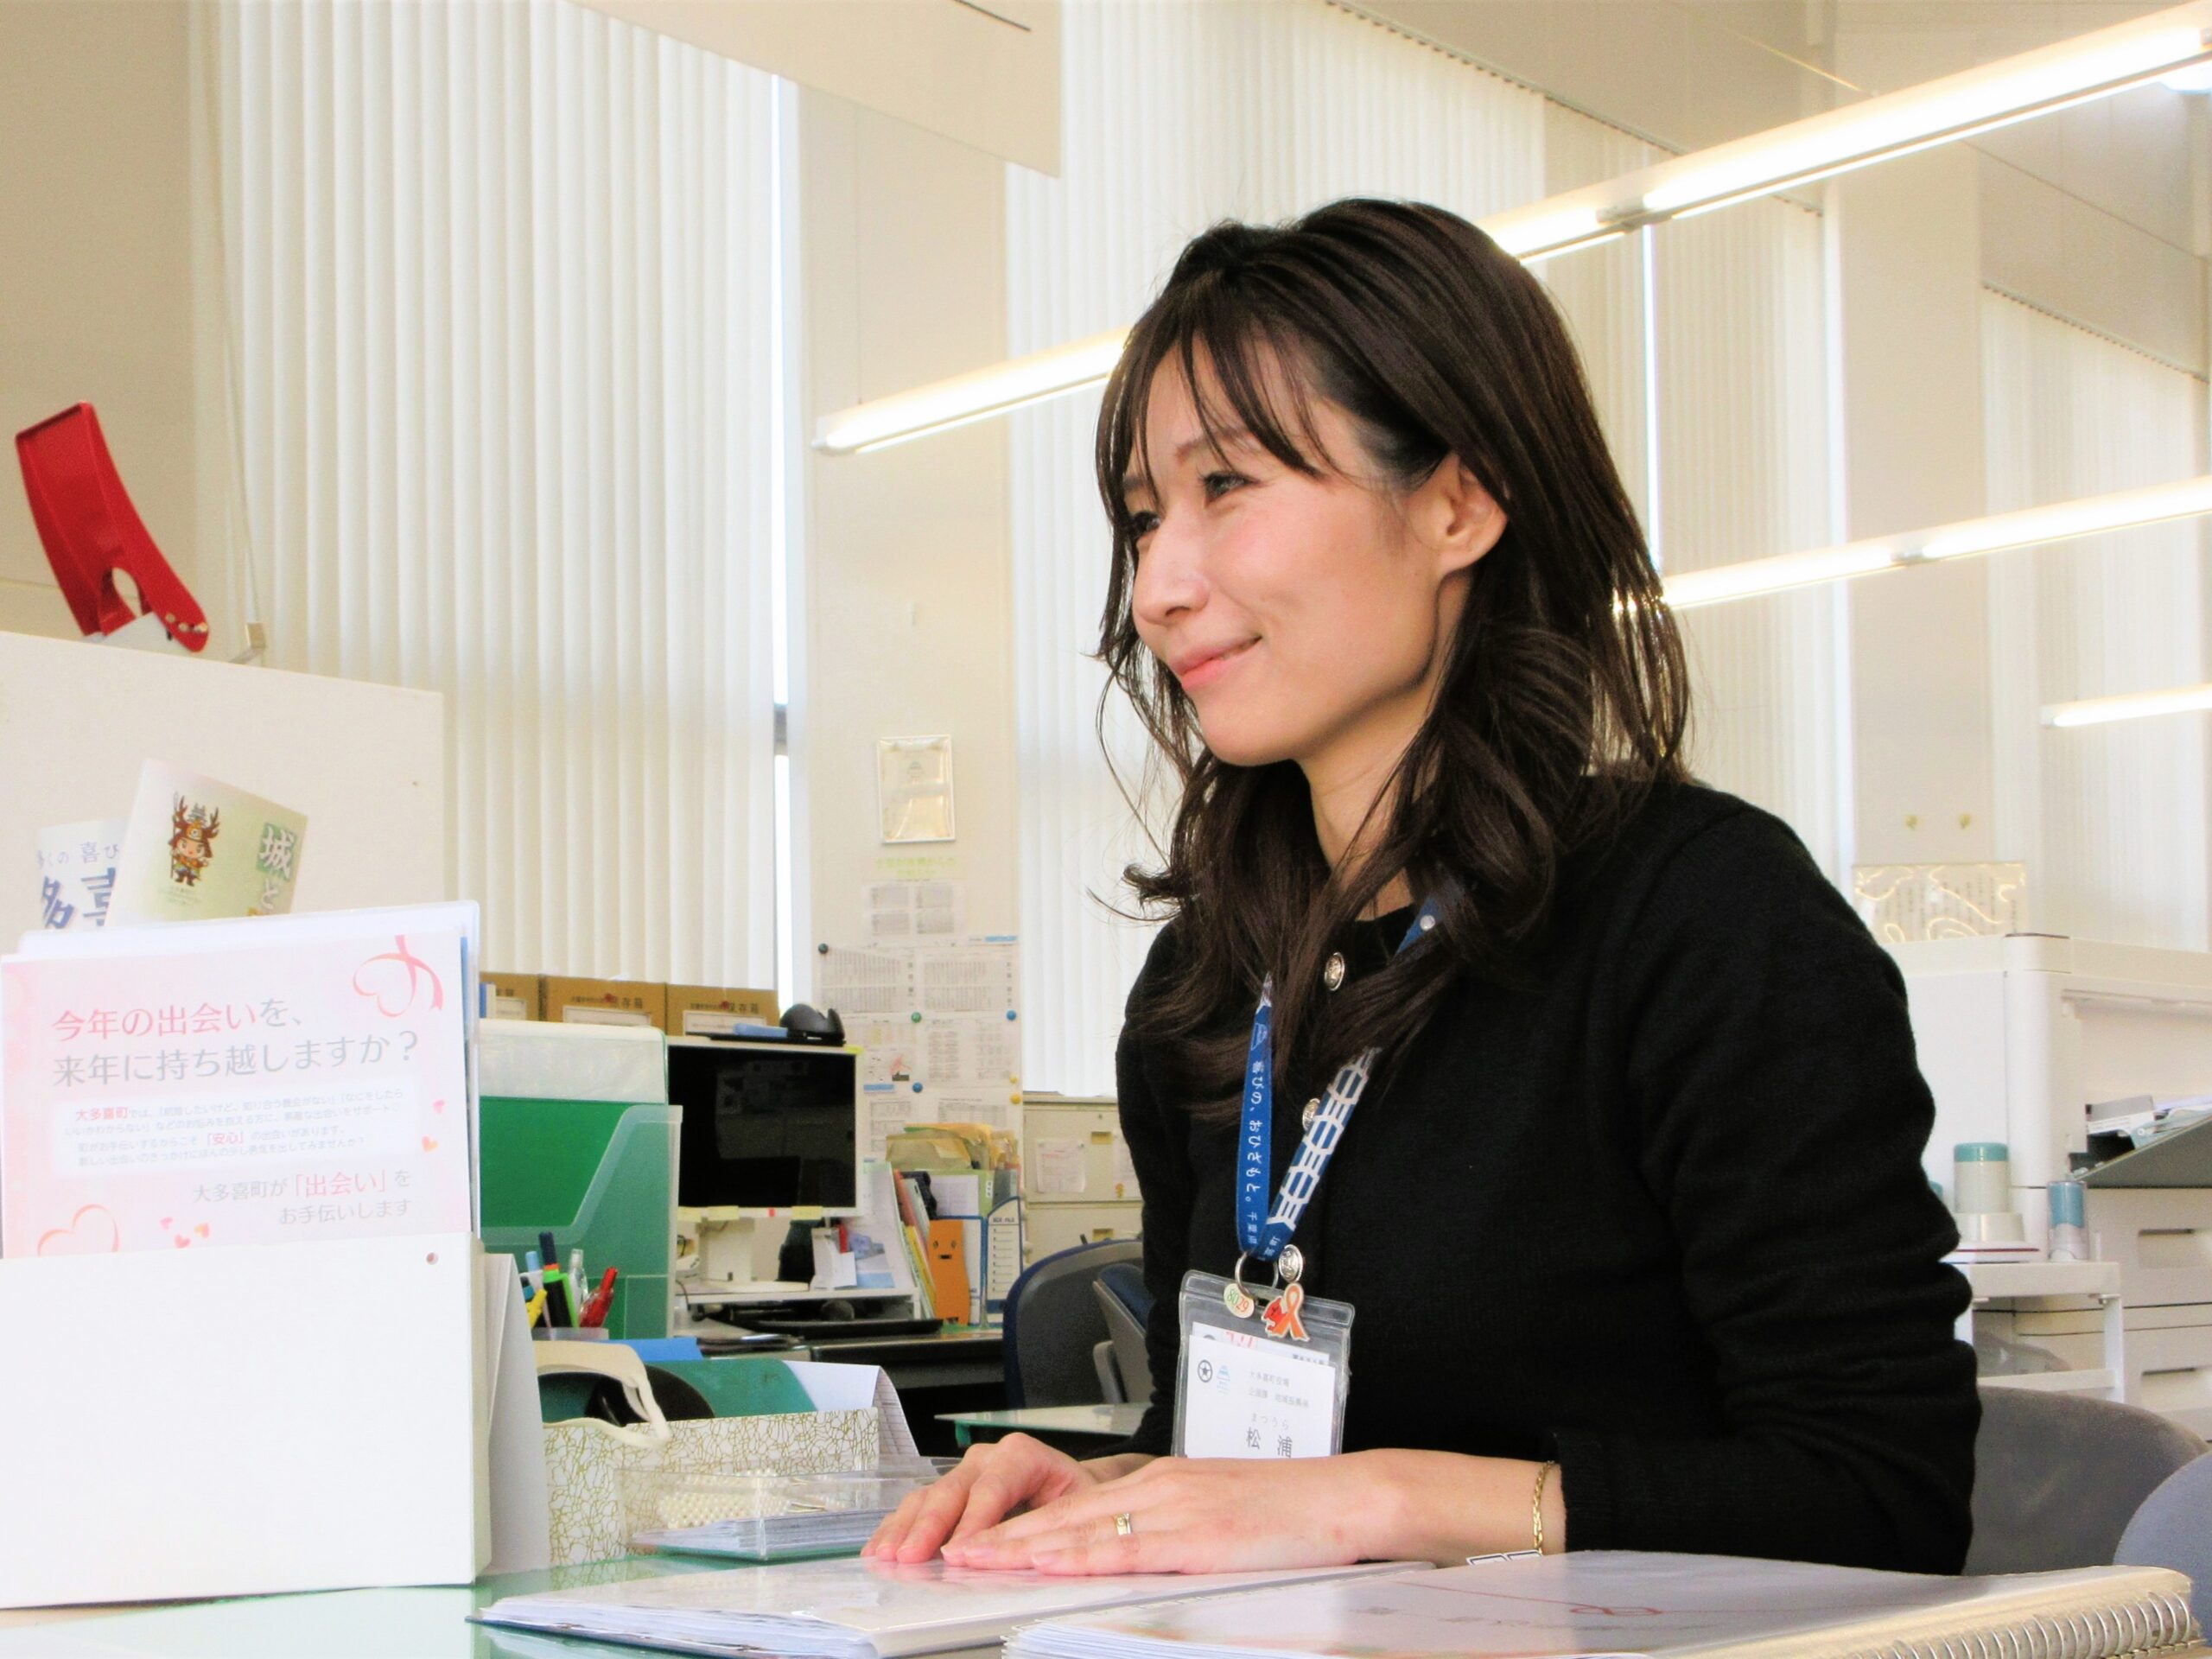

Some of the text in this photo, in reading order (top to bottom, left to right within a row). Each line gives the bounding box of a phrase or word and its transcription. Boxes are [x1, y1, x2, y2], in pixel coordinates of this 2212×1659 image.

[52, 998, 302, 1042] 今年の出会いを、
[53, 1030, 418, 1087] 来年に持ち越しますか？
[279, 1198, 412, 1224] お手伝いします
